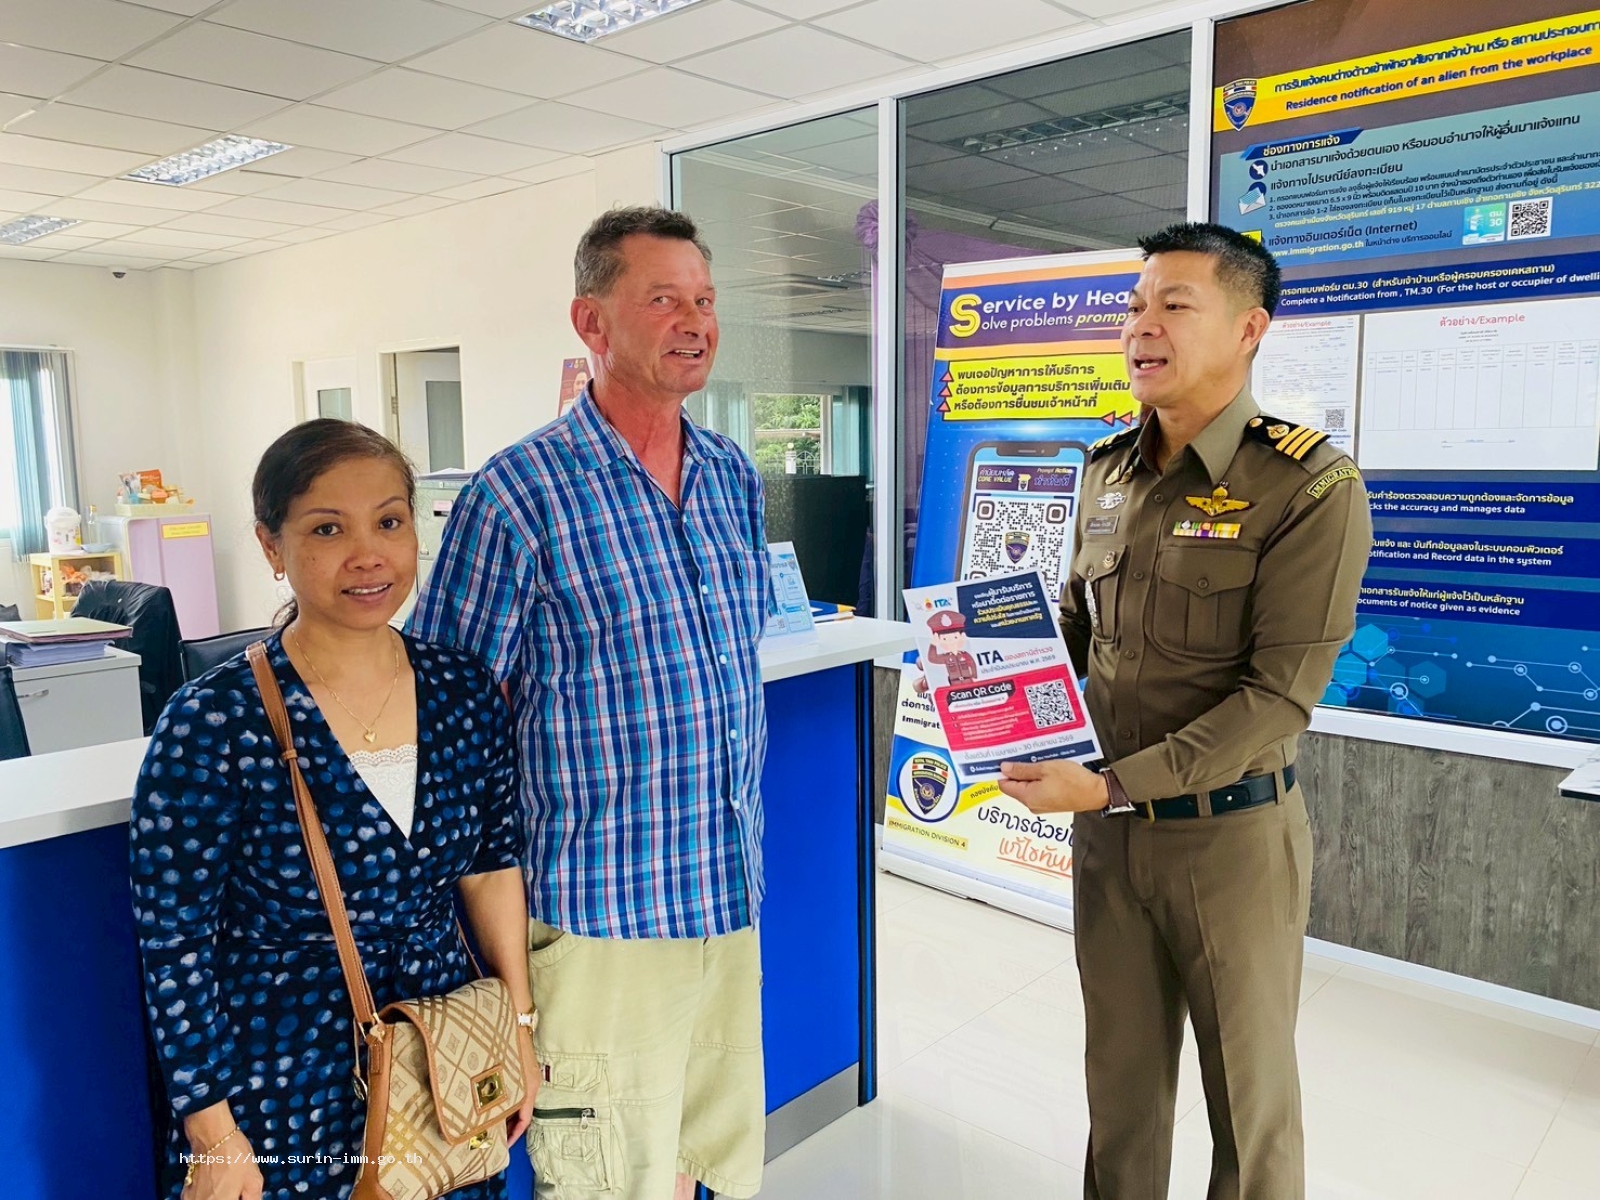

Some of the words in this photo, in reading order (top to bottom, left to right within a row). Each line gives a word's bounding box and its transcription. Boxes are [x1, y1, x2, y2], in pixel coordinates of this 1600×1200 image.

[1487, 36, 1509, 51] หรือ
[1286, 92, 1338, 111] Residence
[1340, 79, 1404, 101] notification
[1406, 76, 1418, 88] of
[1420, 75, 1435, 86] an
[1438, 69, 1467, 82] alien
[1470, 63, 1499, 76] from
[1502, 59, 1523, 70] the
[1526, 45, 1593, 65] workplace
[1263, 134, 1341, 157] ช่องทางการแจ้ง
[1270, 143, 1400, 172] นำเอกสารมาแจ้งด้วยตนเอง
[1402, 114, 1581, 151] หรือมอบอำนาจให้ผู้อื่นมาแจ้งแทน
[1270, 163, 1403, 191] แจ้งทางไปรษณีย์ลงทะเบียน
[1330, 195, 1341, 204] 6.5
[1415, 184, 1424, 192] 10
[1316, 206, 1328, 214] 1-2
[1388, 205, 1403, 214] 919
[1489, 218, 1503, 227] 30
[1269, 225, 1363, 247] แจ้งทางอินเตอร์เน็ต
[1365, 220, 1418, 236] (Internet)
[1280, 296, 1318, 307] Complete
[1326, 292, 1376, 303] Notification
[1377, 290, 1398, 299] from
[1404, 286, 1433, 296] TM.30
[1436, 284, 1456, 294] (For
[1457, 281, 1474, 292] the
[1475, 279, 1497, 290] host
[1511, 275, 1554, 289] occupier
[1556, 274, 1567, 283] of
[1342, 280, 1369, 291] ตม.30
[949, 293, 1046, 338] Service
[1052, 293, 1079, 311] by
[1010, 312, 1073, 332] problems
[1075, 314, 1129, 327] promp
[1439, 313, 1526, 327] ตัวอย่าง/Example
[958, 364, 1095, 380] พบเจอปัญหาการให้บริการ
[955, 377, 1131, 396] ต้องการข้อมูลการบริการเพิ่มเติม
[954, 393, 1098, 411] หรือต้องการชื่นชมเจ้าหน้าที่
[1384, 503, 1399, 511] the
[1400, 504, 1439, 514] accuracy
[1440, 504, 1458, 513] and
[1460, 505, 1502, 515] manages
[1504, 505, 1526, 514] data
[1412, 551, 1430, 560] and
[1431, 552, 1463, 562] Record
[1464, 553, 1485, 563] data
[1487, 554, 1496, 563] in
[1498, 555, 1515, 564] the
[1517, 557, 1552, 567] system
[1357, 598, 1398, 608] ocuments
[1399, 599, 1409, 608] of
[1410, 600, 1438, 610] notice
[1440, 603, 1465, 612] given
[1466, 605, 1477, 613] as
[1478, 606, 1520, 616] evidence
[976, 650, 1004, 666] ITA
[950, 689, 973, 701] Scan
[973, 687, 987, 697] QR
[988, 682, 1012, 694] Code
[902, 715, 941, 729] Immigrat
[1023, 743, 1032, 751] 30
[888, 820, 930, 838] IMMIGRATION
[930, 831, 960, 847] DIVISION
